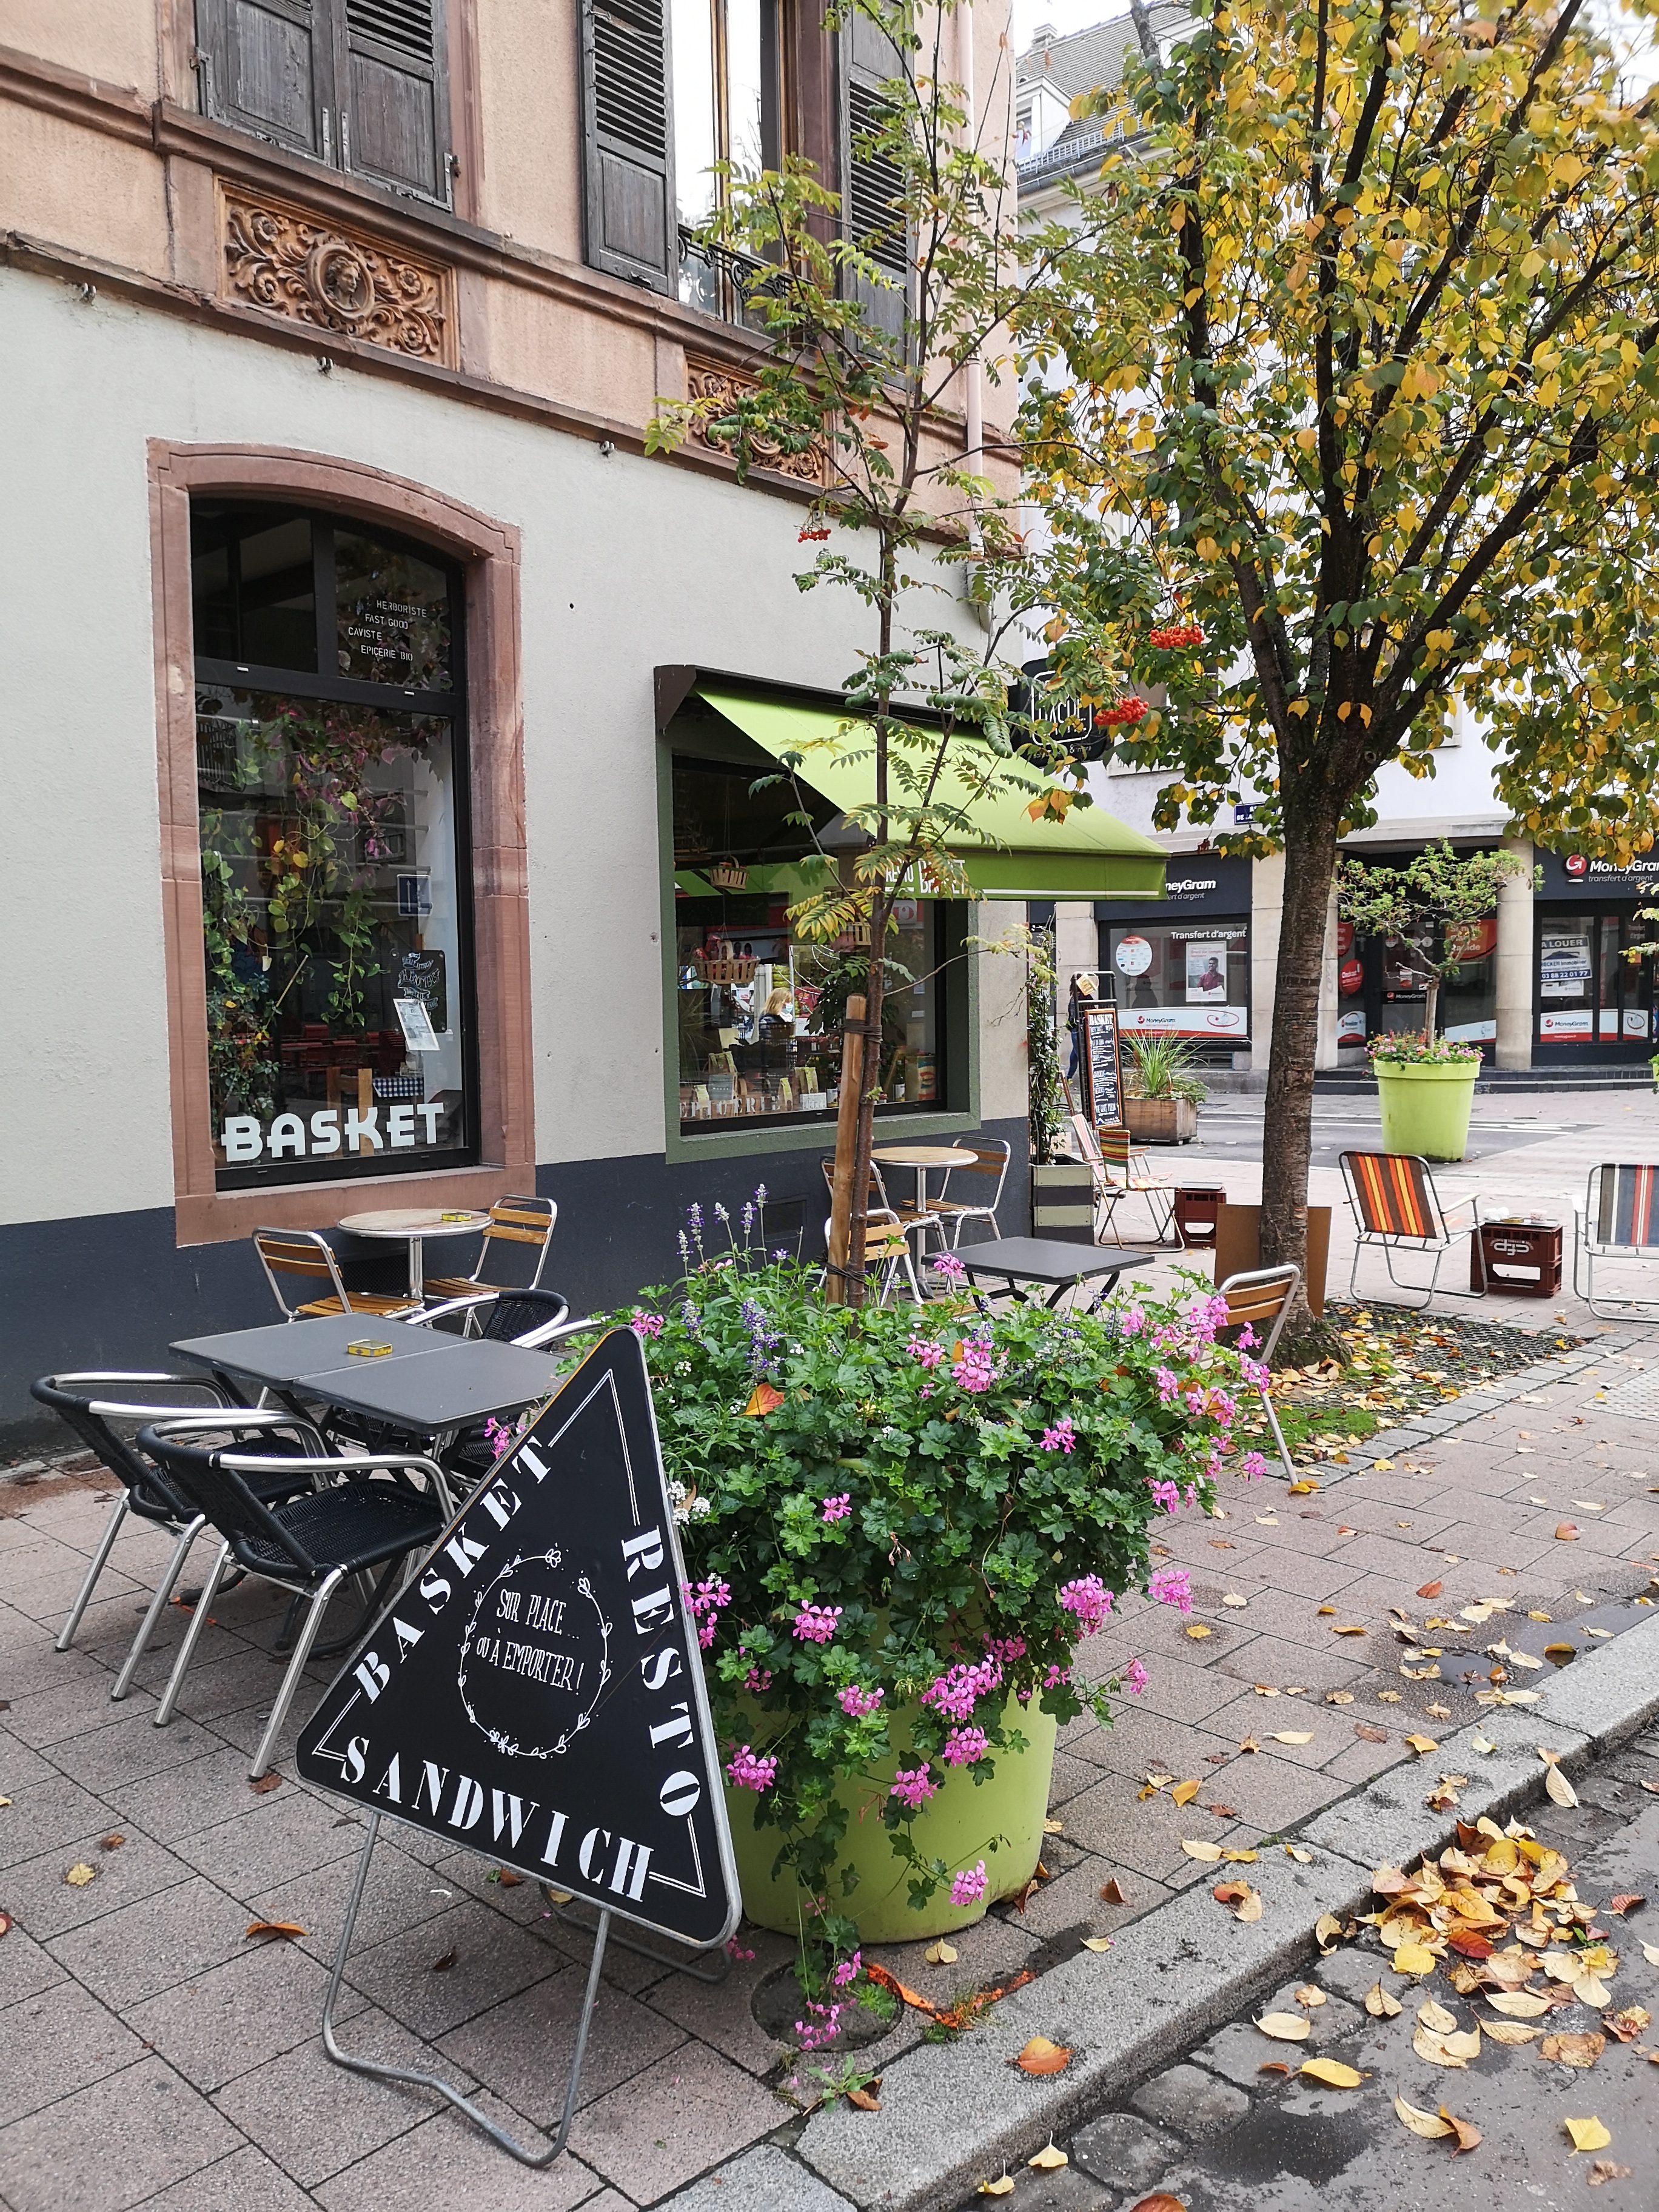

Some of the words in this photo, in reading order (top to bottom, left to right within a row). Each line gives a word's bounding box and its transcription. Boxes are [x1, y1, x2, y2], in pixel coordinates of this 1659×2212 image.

[377, 600, 427, 618] HERBORISTE
[365, 613, 384, 625] FAST
[388, 618, 409, 629] GOOD
[348, 626, 382, 641] CAVISTE
[361, 645, 397, 659] EPICERIE
[401, 651, 414, 662] BIO
[1165, 879, 1216, 893] neyGram
[1622, 874, 1653, 883] d'argent
[1177, 892, 1205, 900] d'argent
[1171, 931, 1210, 939] Transfert
[1211, 929, 1247, 939] d'argent
[1549, 939, 1583, 948] LOUER
[1089, 1014, 1113, 1025] BASKET
[221, 1102, 444, 1162] BASKET
[352, 1435, 551, 1704] BASKET
[496, 1589, 521, 1623] SUR
[476, 1637, 491, 1658] OU
[488, 1627, 501, 1666] À
[621, 1525, 700, 1817] RESTO
[340, 1735, 654, 1903] SANDWICH
